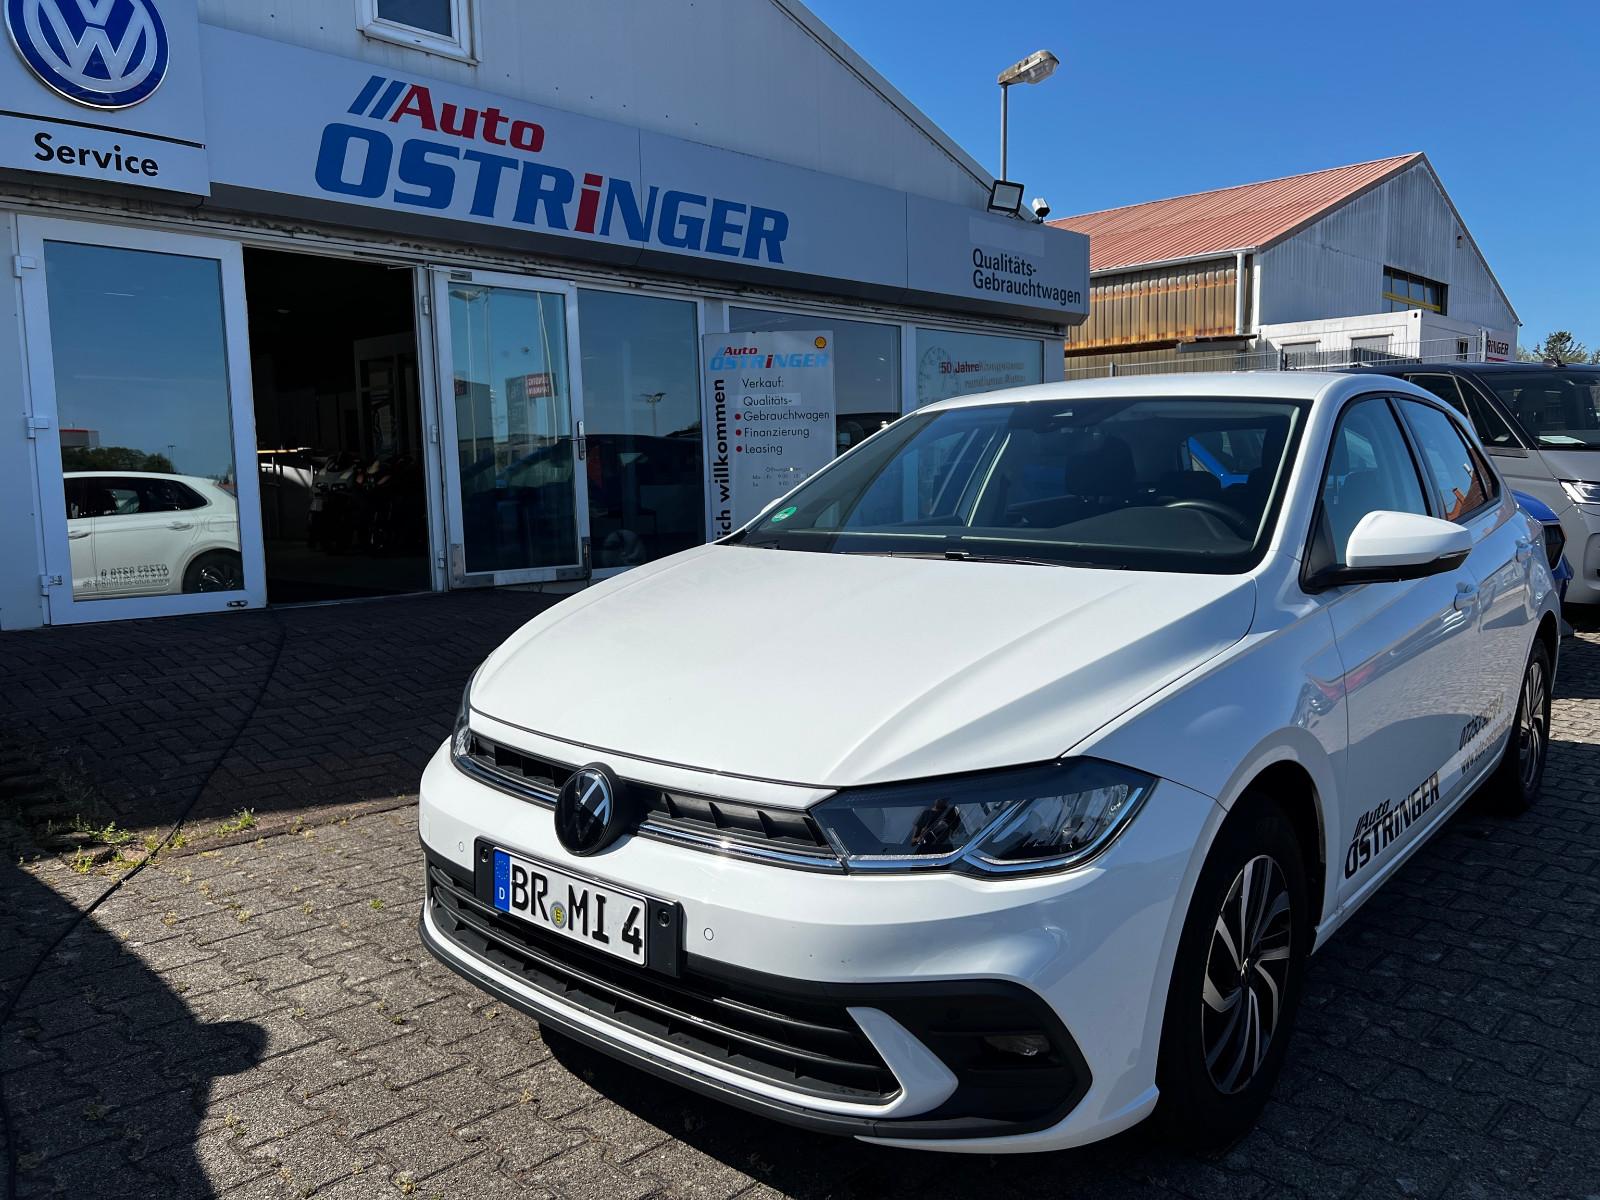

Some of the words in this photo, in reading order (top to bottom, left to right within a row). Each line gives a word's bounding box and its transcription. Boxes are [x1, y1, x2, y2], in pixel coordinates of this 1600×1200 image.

[390, 85, 545, 154] Auto
[34, 132, 159, 177] Service
[972, 248, 1037, 275] Qualitäts-
[972, 269, 1081, 305] Gebrauchtwagen
[724, 346, 758, 356] Auto
[955, 360, 980, 374] Jahre
[741, 377, 784, 389] Verkauf:
[743, 395, 792, 407] Qualitäts-
[743, 409, 830, 422] Gebrauchtwagen
[744, 427, 810, 439] Finanzierung
[713, 379, 731, 503] willkommen
[745, 444, 783, 456] Leasing
[1361, 798, 1391, 829] Auto
[498, 887, 505, 900] D
[511, 863, 549, 921] BR
[567, 884, 609, 944] MI
[621, 905, 643, 955] 4
